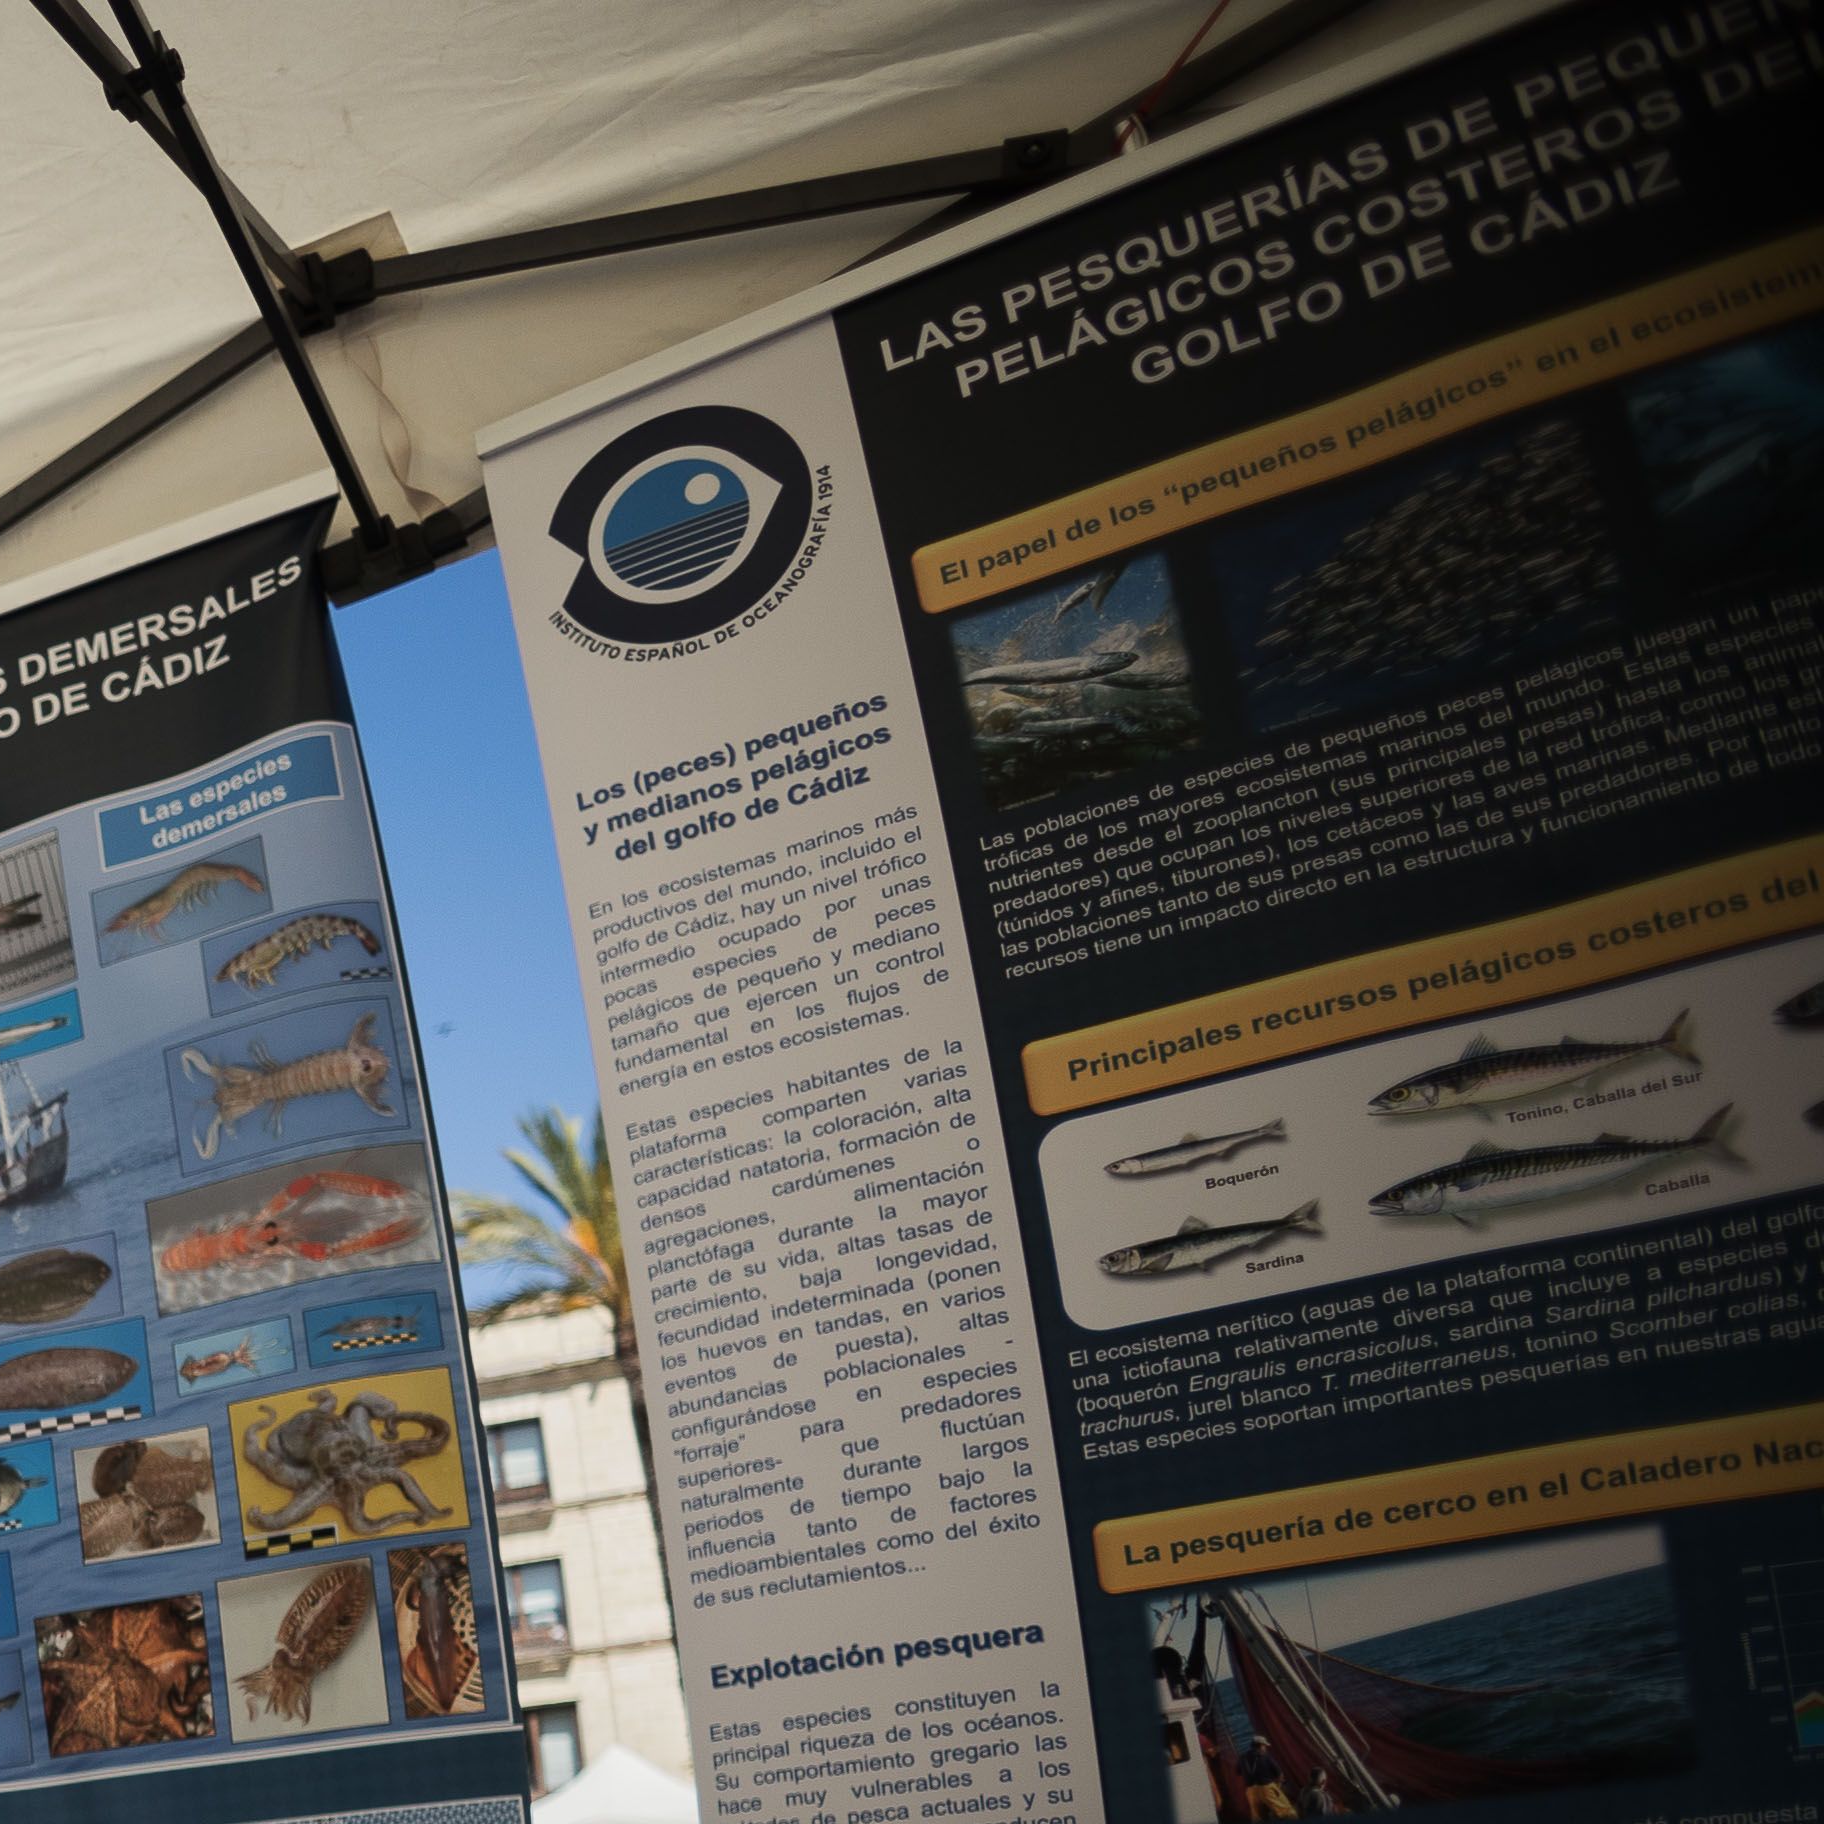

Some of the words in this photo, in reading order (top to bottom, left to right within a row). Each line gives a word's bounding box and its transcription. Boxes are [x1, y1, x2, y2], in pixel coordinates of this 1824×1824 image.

[880, 305, 987, 372] LAS
[1002, 142, 1389, 324] PESQUERÍAS
[1405, 98, 1497, 161] DE
[955, 240, 1295, 398] PELÁGICOS
[1313, 89, 1682, 255] COSTEROS
[1131, 281, 1343, 384] GOLFO
[1361, 234, 1452, 299] DE
[1470, 153, 1677, 254] CÁDIZ
[939, 559, 969, 585] El
[977, 528, 1057, 578] papel
[1065, 518, 1102, 542] de
[1108, 498, 1156, 527] los
[1535, 346, 1580, 373] en
[1589, 326, 1621, 355] el
[548, 610, 622, 659] INSTITUTO
[624, 639, 710, 662] ESPAÑOL
[714, 624, 740, 644] DE
[742, 504, 832, 628] OCEANOGRAFÍA
[815, 464, 834, 501] 1914
[18, 555, 302, 686] DEMERSALES
[32, 682, 90, 726] DE
[101, 634, 230, 702] CÁDIZ
[139, 799, 184, 825] Las
[189, 754, 292, 808] especies
[576, 782, 626, 812] Los
[633, 742, 736, 796] (peces)
[744, 695, 888, 761] pequeños
[581, 822, 600, 847] y
[606, 777, 743, 833] medianos
[750, 727, 892, 792] pelágicos
[151, 785, 287, 849] demersales
[588, 901, 613, 920] En
[621, 889, 649, 908] los
[658, 851, 777, 897] ecosistemas
[786, 822, 865, 857] marinos
[874, 806, 918, 829] más
[615, 831, 657, 861] del
[664, 810, 737, 851] golfo
[744, 797, 779, 821] de
[787, 766, 871, 806] Cádiz
[592, 898, 698, 945] productivos
[704, 884, 734, 906] del
[740, 865, 813, 895] mundo,
[819, 836, 896, 870] incluido
[903, 825, 922, 844] el
[1067, 1023, 1242, 1082] Principales
[1251, 983, 1398, 1035] recursos
[1407, 941, 1577, 1001] pelágicos
[1587, 893, 1749, 952] costeros
[1761, 868, 1820, 905] del
[1505, 1105, 1569, 1123] Tonino,
[1572, 1087, 1637, 1110] Caballa
[1640, 1078, 1668, 1095] del
[1671, 1071, 1703, 1087] Sur
[1205, 1165, 1280, 1190] Boquerón
[1644, 1173, 1711, 1196] Caballa
[1245, 1254, 1305, 1274] Sardina
[1123, 1544, 1161, 1566] La
[1170, 1515, 1325, 1564] pesquería
[1334, 1508, 1374, 1532] de
[1383, 1494, 1477, 1524] cerco
[1486, 1485, 1529, 1508] en
[1539, 1472, 1569, 1499] el
[1580, 1453, 1742, 1492] Caladero
[710, 1643, 885, 1690] Explotación
[894, 1624, 1045, 1668] pesquera
